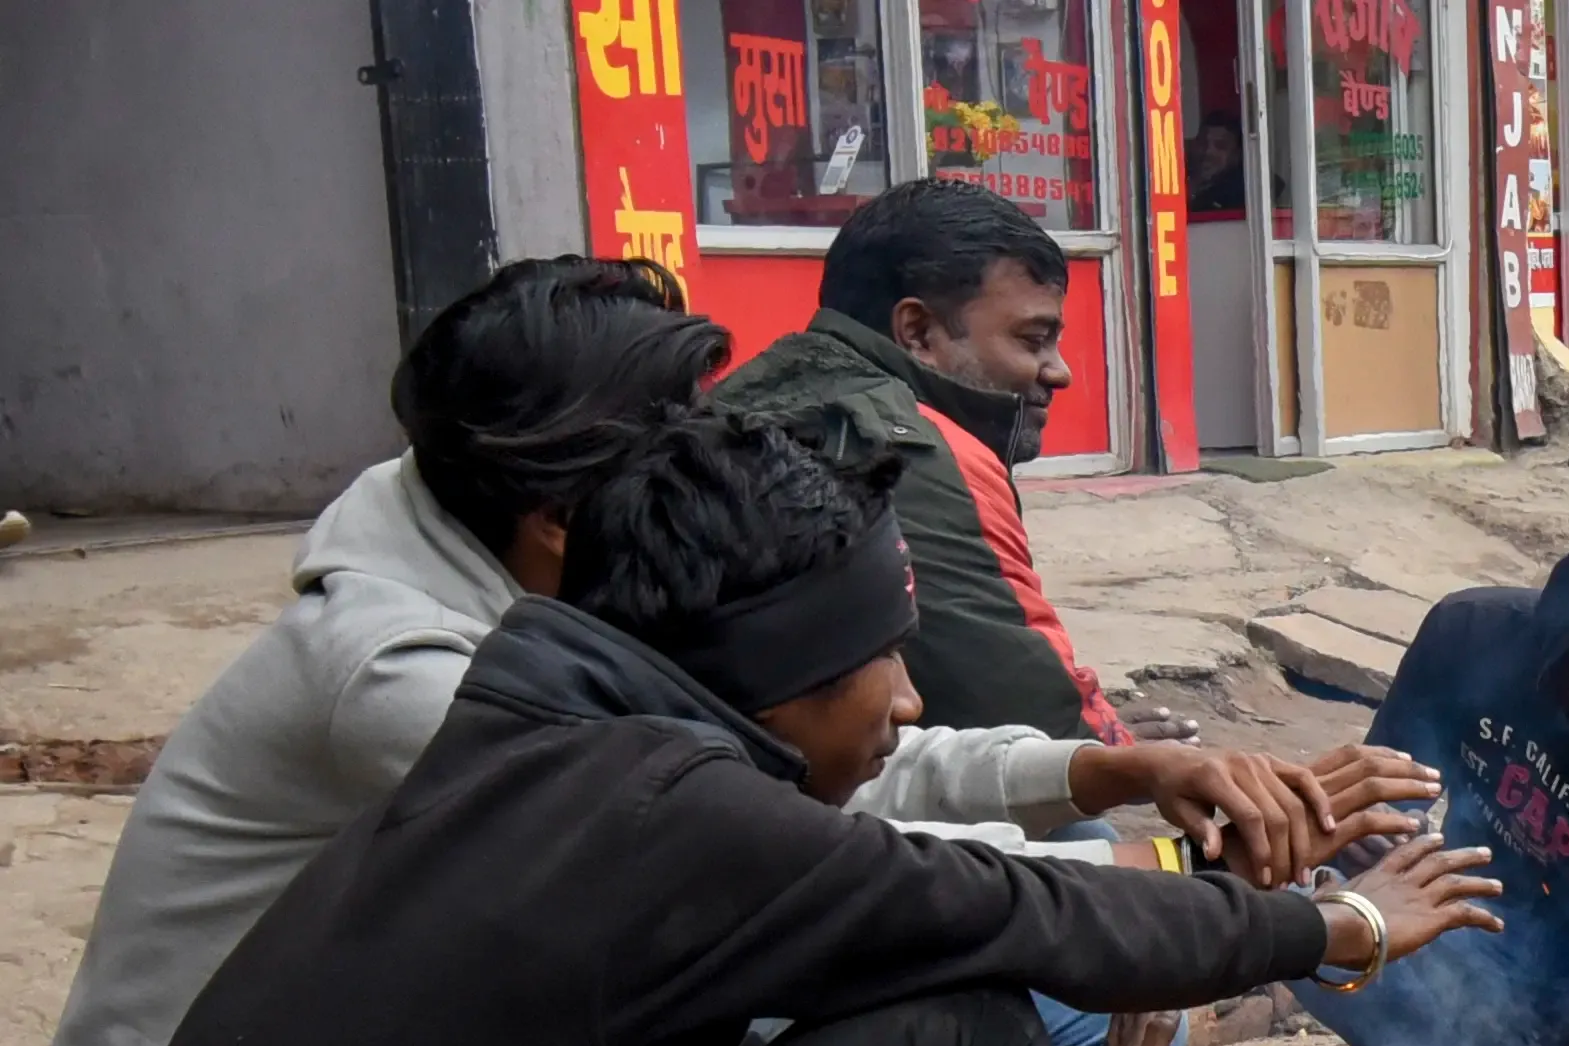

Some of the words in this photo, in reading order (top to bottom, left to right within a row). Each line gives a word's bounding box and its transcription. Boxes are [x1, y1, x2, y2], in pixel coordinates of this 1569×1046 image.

[730, 33, 805, 164] मुसा
[1147, 0, 1179, 296] OME
[1460, 740, 1490, 783] EST.
[1479, 717, 1516, 749] S.F.
